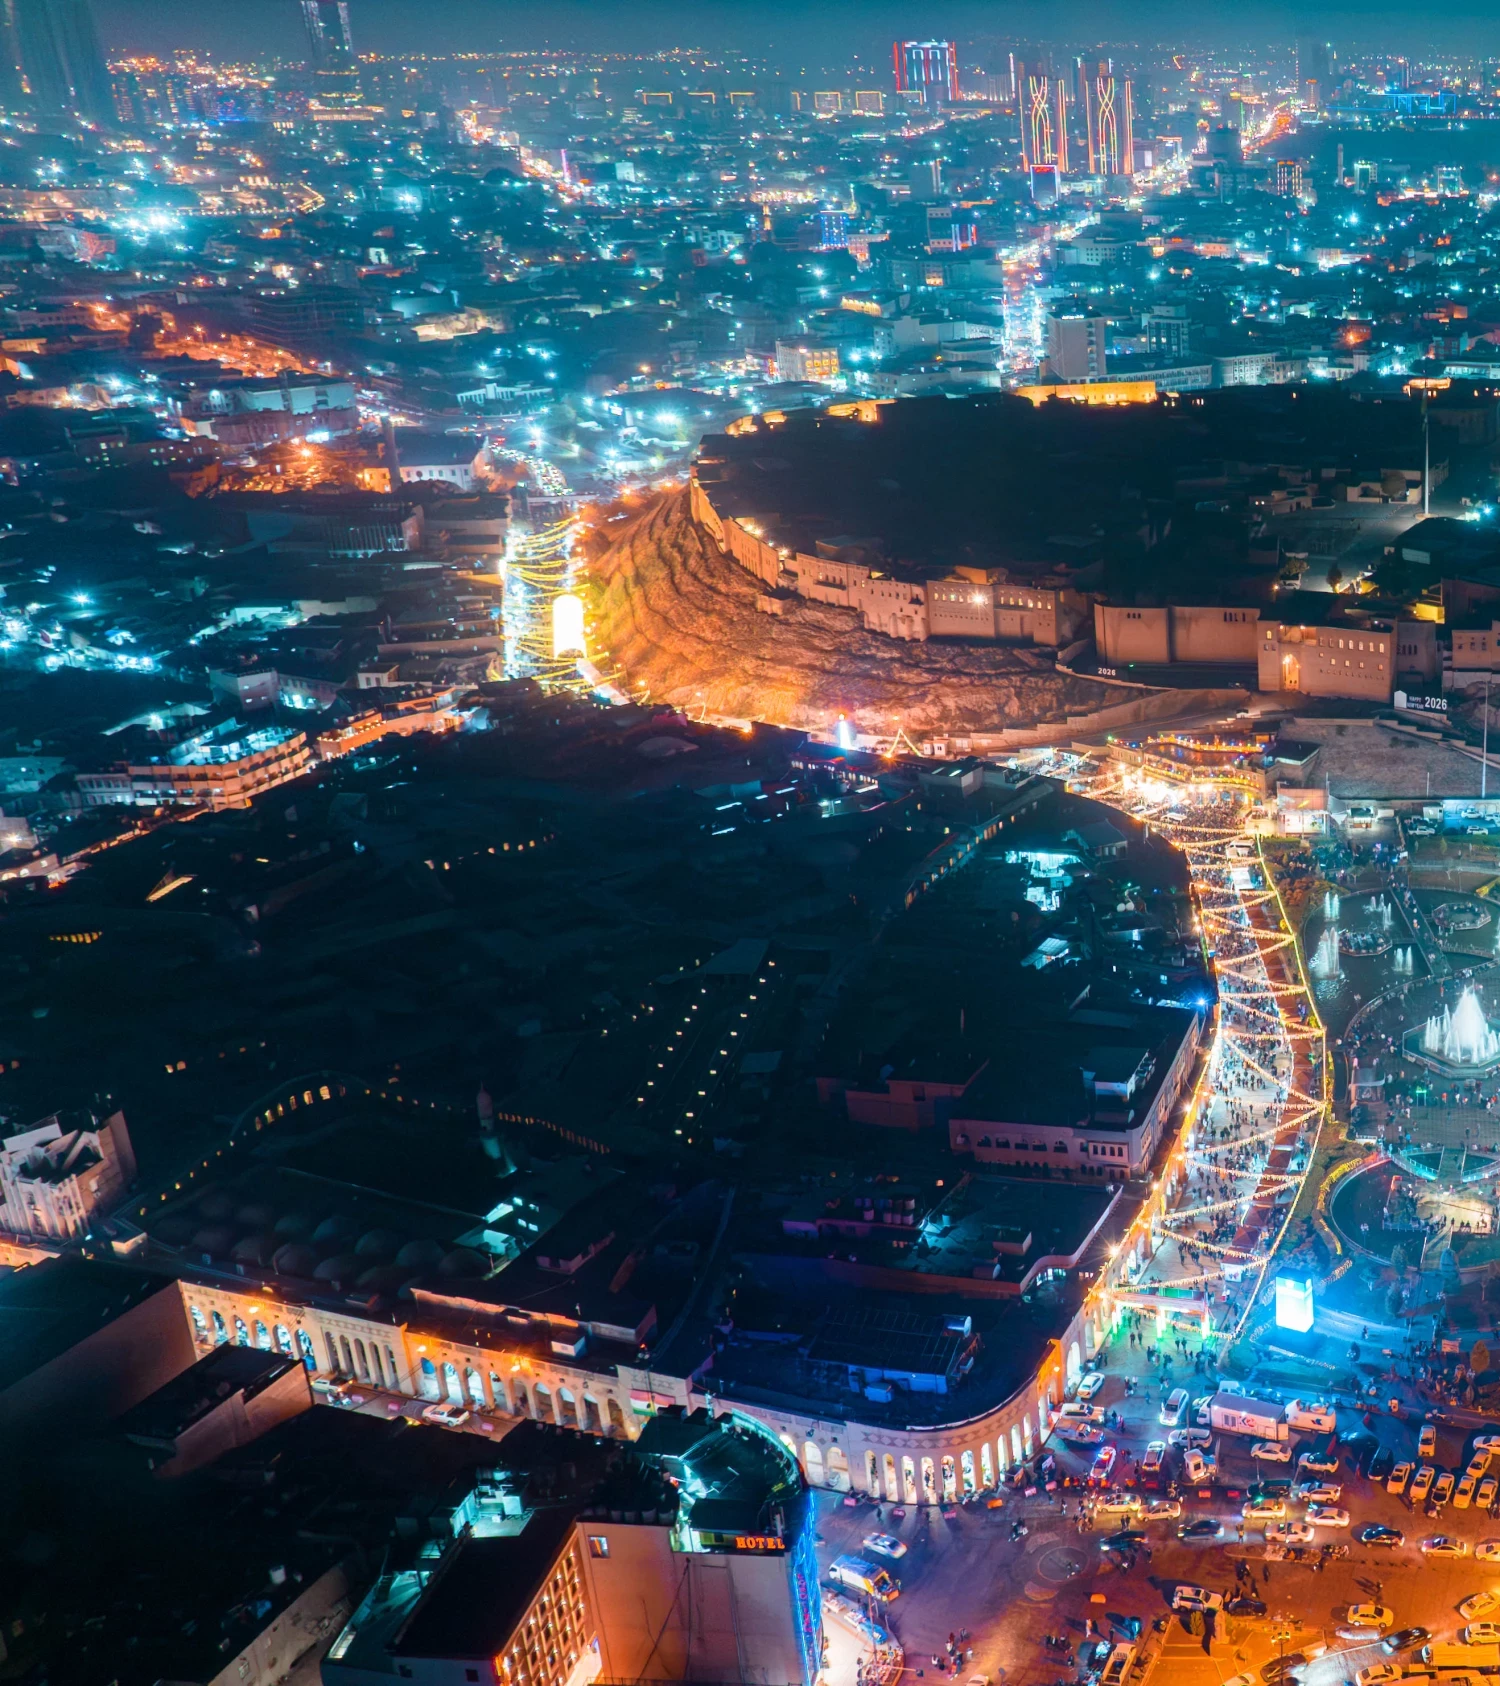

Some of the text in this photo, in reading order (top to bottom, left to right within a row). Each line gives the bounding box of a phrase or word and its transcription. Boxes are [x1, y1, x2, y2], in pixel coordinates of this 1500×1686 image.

[1098, 668, 1116, 676] 2026
[1425, 696, 1447, 710] 2026
[736, 1537, 785, 1549] HOTEL
